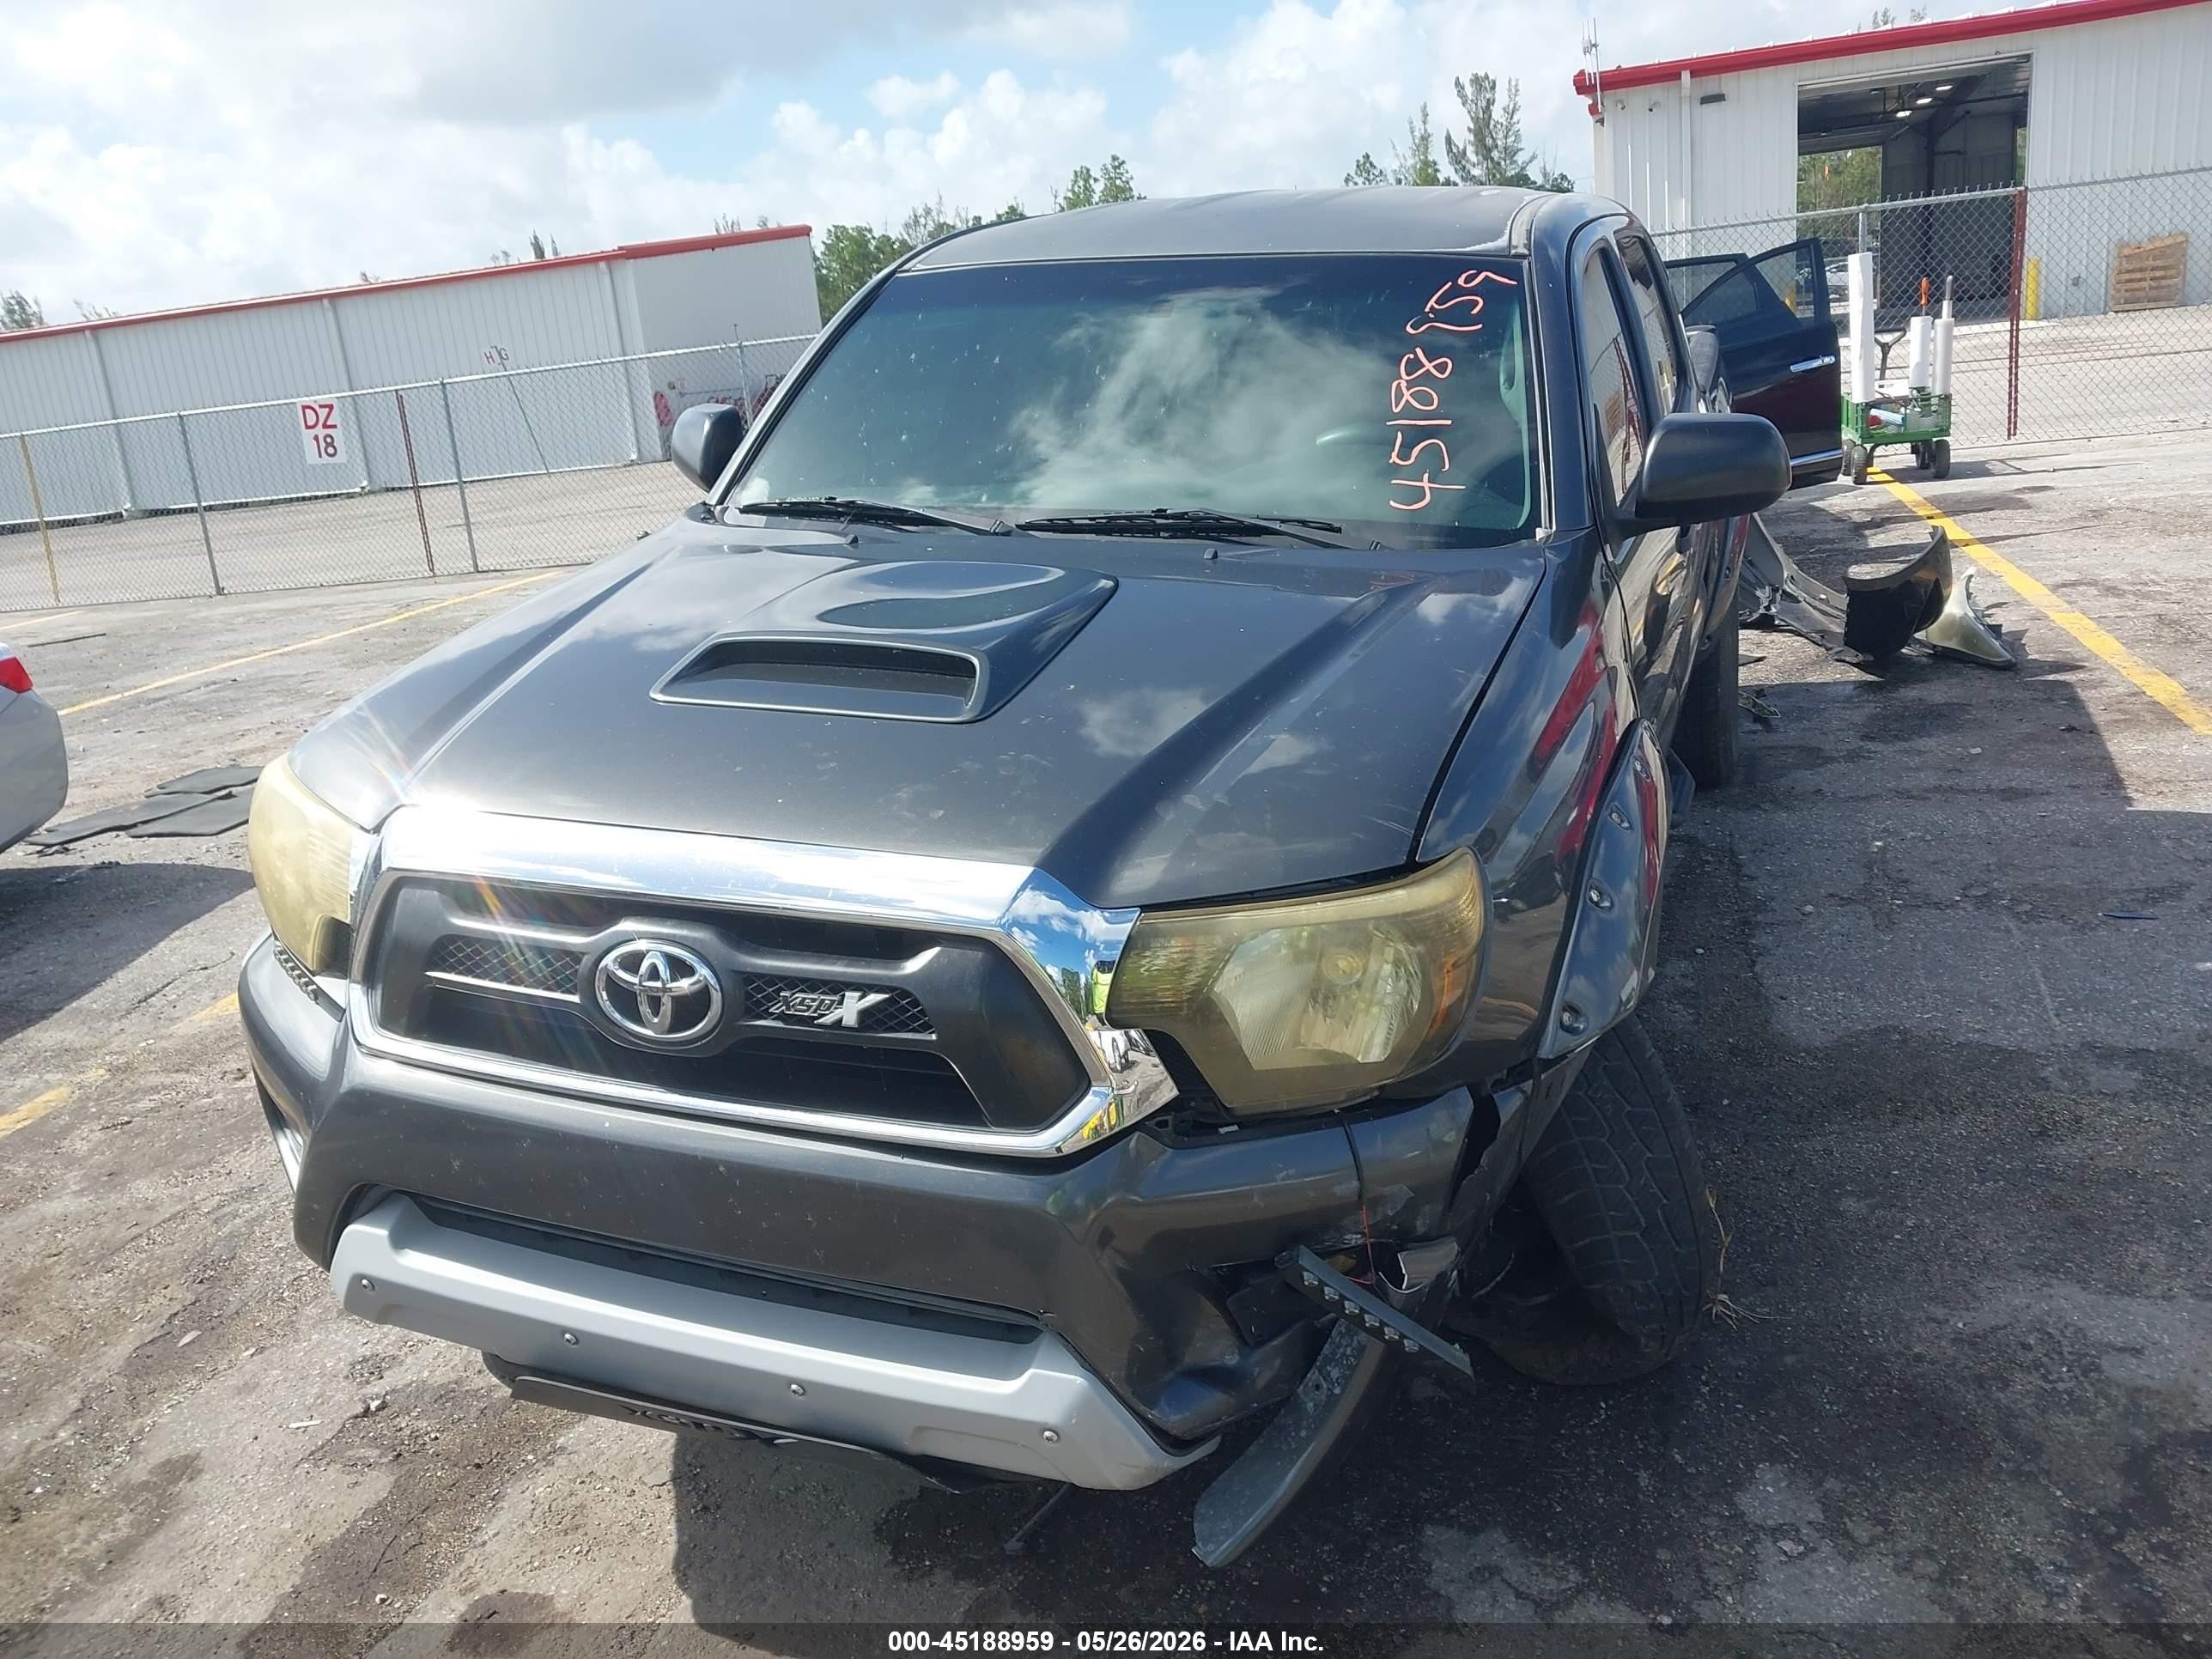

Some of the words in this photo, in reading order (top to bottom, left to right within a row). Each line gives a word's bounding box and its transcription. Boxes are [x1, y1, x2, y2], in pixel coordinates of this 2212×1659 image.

[1386, 269, 1518, 510] 45188959
[301, 404, 337, 429] DZ
[313, 434, 337, 458] 18
